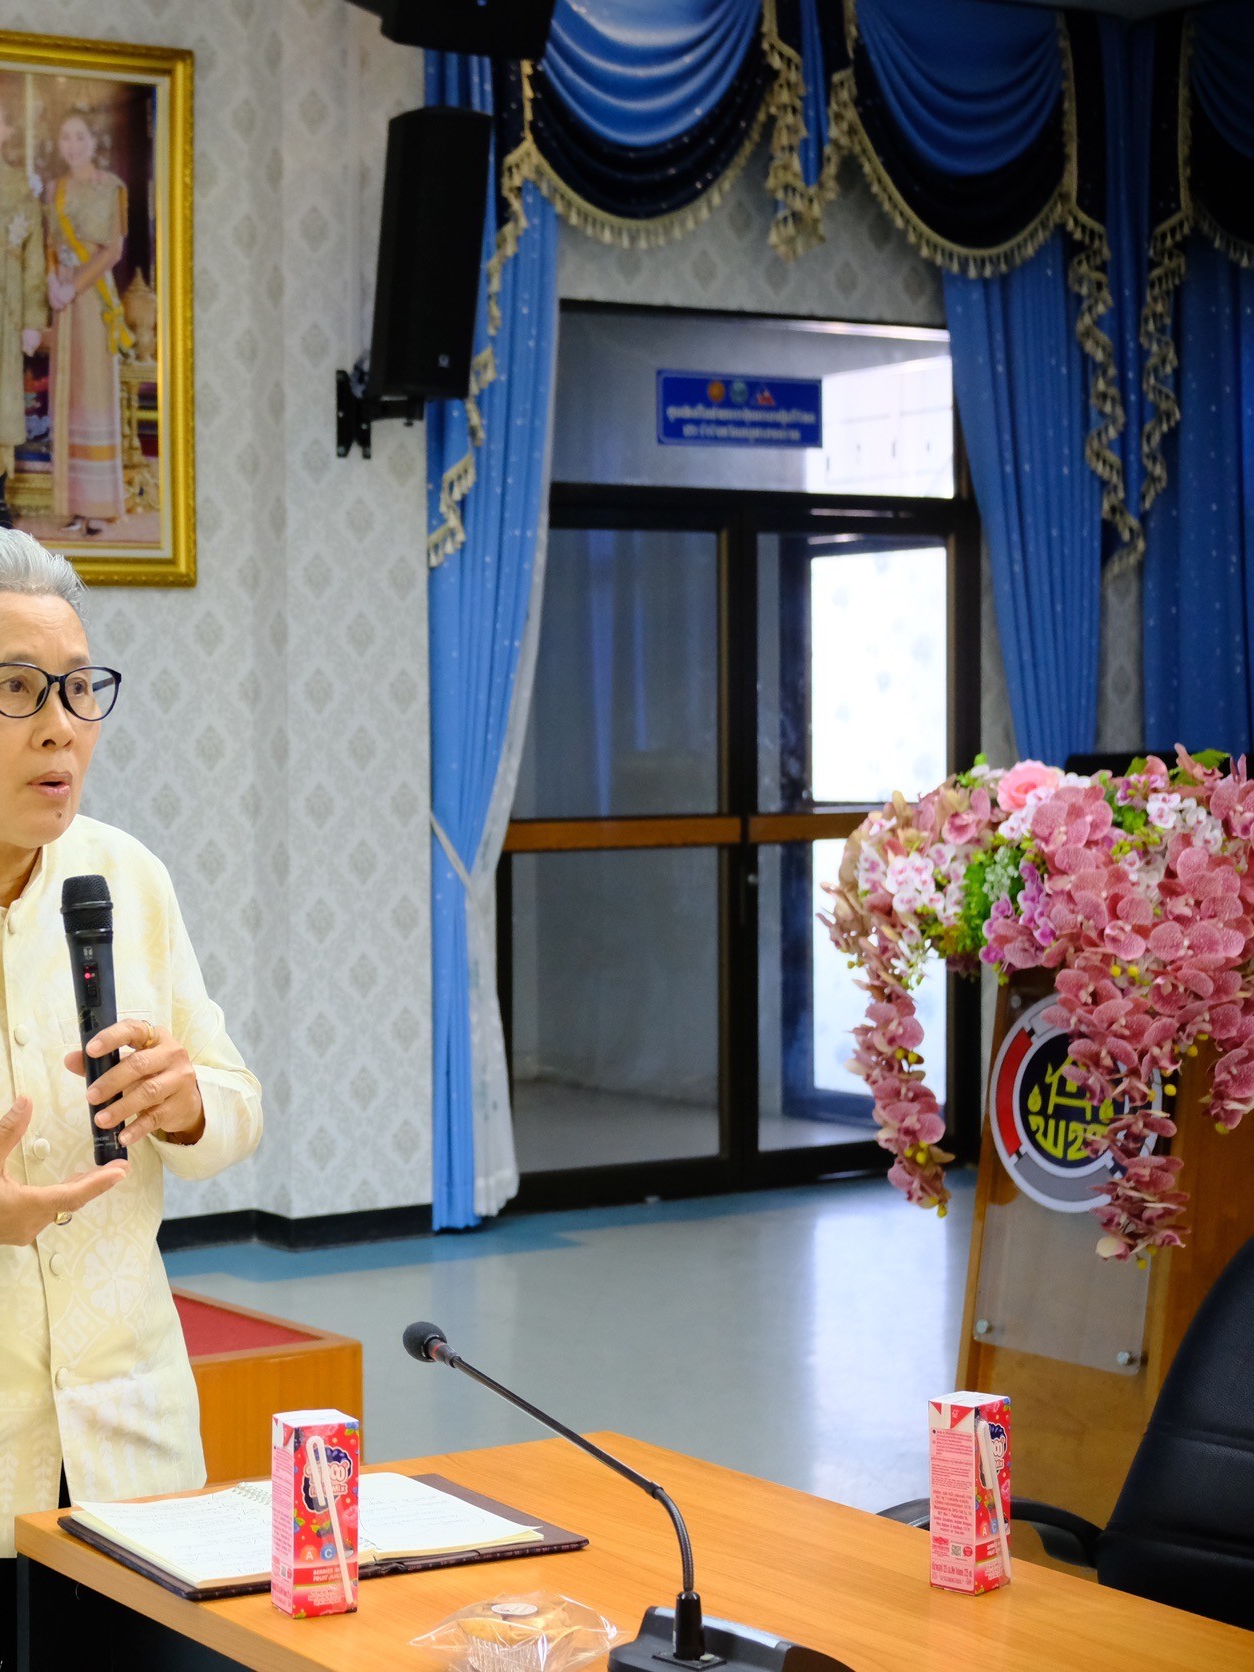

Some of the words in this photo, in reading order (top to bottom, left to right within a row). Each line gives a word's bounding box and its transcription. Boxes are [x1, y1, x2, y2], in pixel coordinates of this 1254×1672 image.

[305, 1551, 314, 1561] A
[324, 1548, 333, 1559] C
[328, 1573, 342, 1581] JUIC
